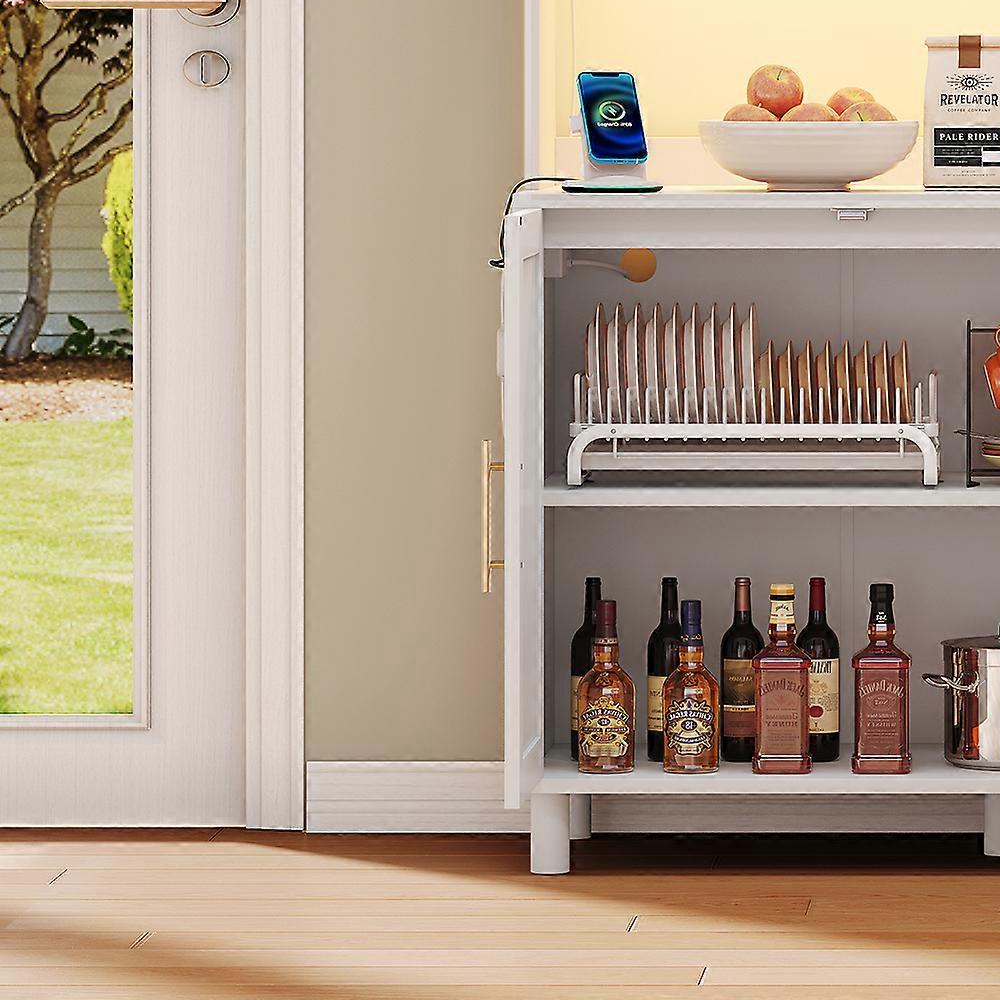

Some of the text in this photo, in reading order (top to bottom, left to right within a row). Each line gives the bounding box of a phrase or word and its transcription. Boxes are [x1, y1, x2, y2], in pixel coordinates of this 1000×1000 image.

[940, 93, 999, 107] REVELATOR
[939, 133, 1000, 141] PALE RIDER
